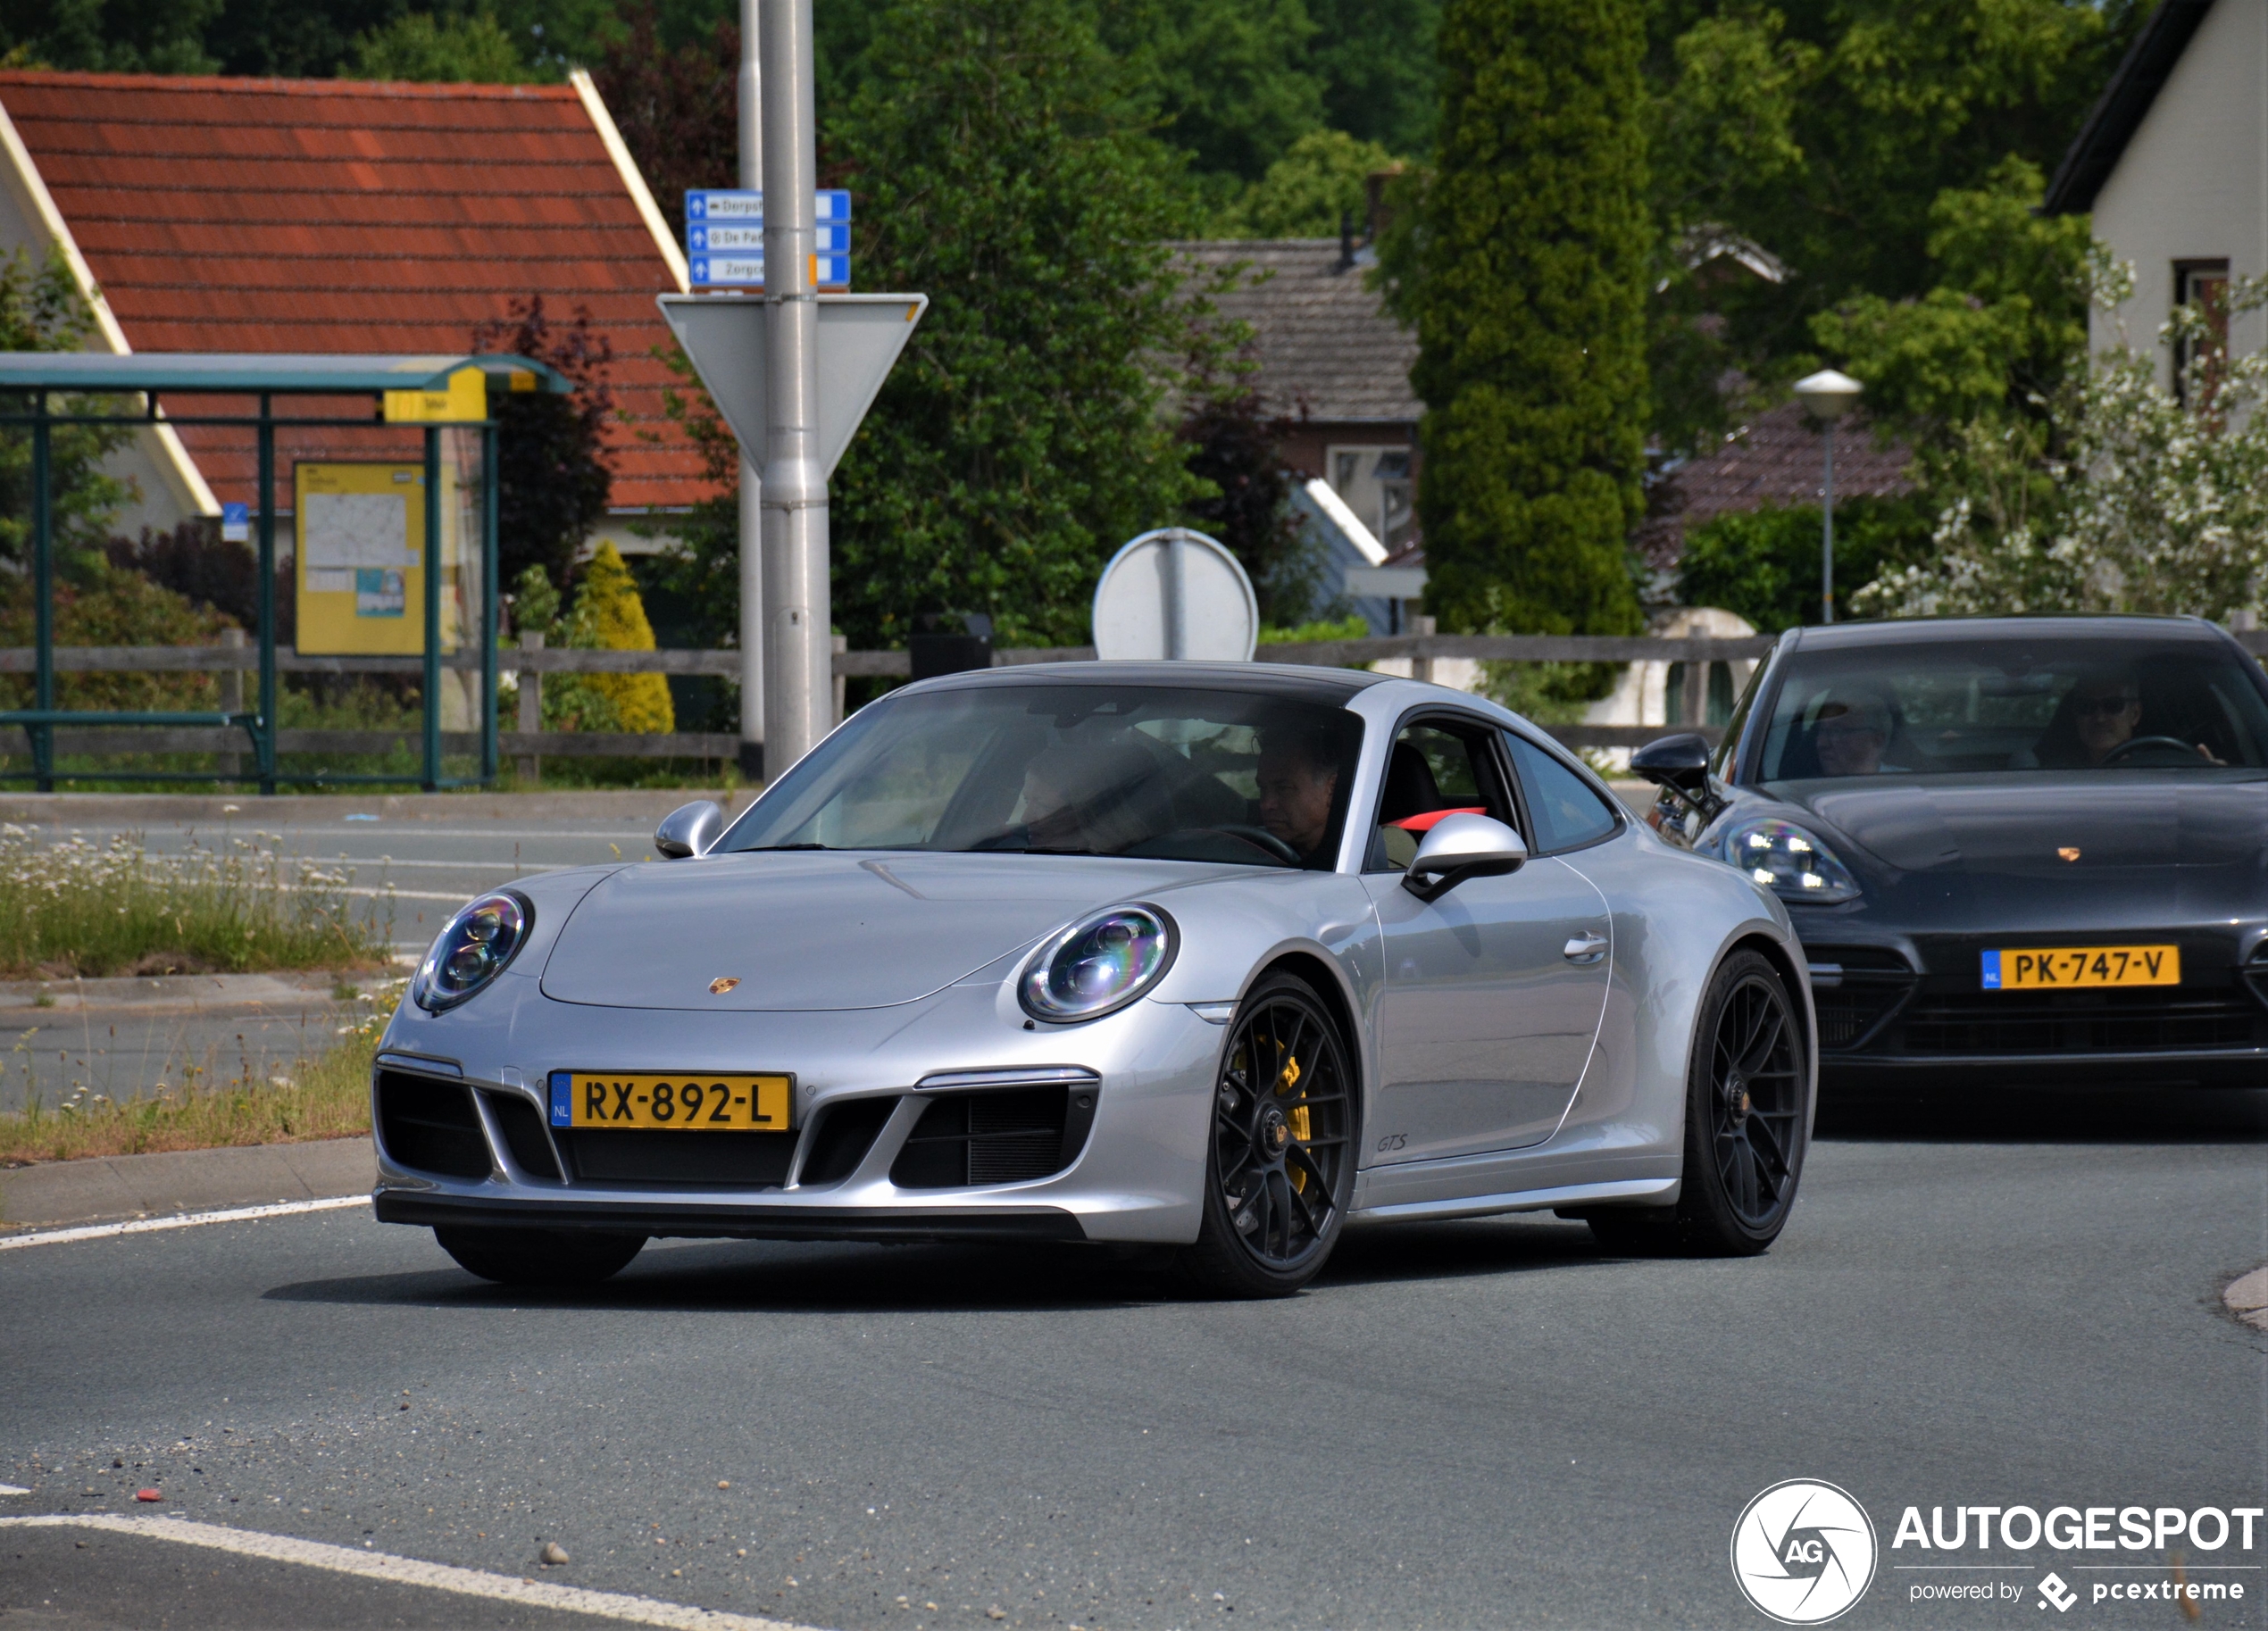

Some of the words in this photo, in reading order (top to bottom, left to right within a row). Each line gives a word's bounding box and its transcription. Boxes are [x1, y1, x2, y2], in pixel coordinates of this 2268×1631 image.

[724, 230, 739, 244] De
[2016, 951, 2164, 983] PK-747-V
[1986, 973, 1999, 982] NL
[586, 1081, 771, 1122] RX-892-L
[554, 1106, 569, 1118] NL
[1378, 1134, 1408, 1153] GTS
